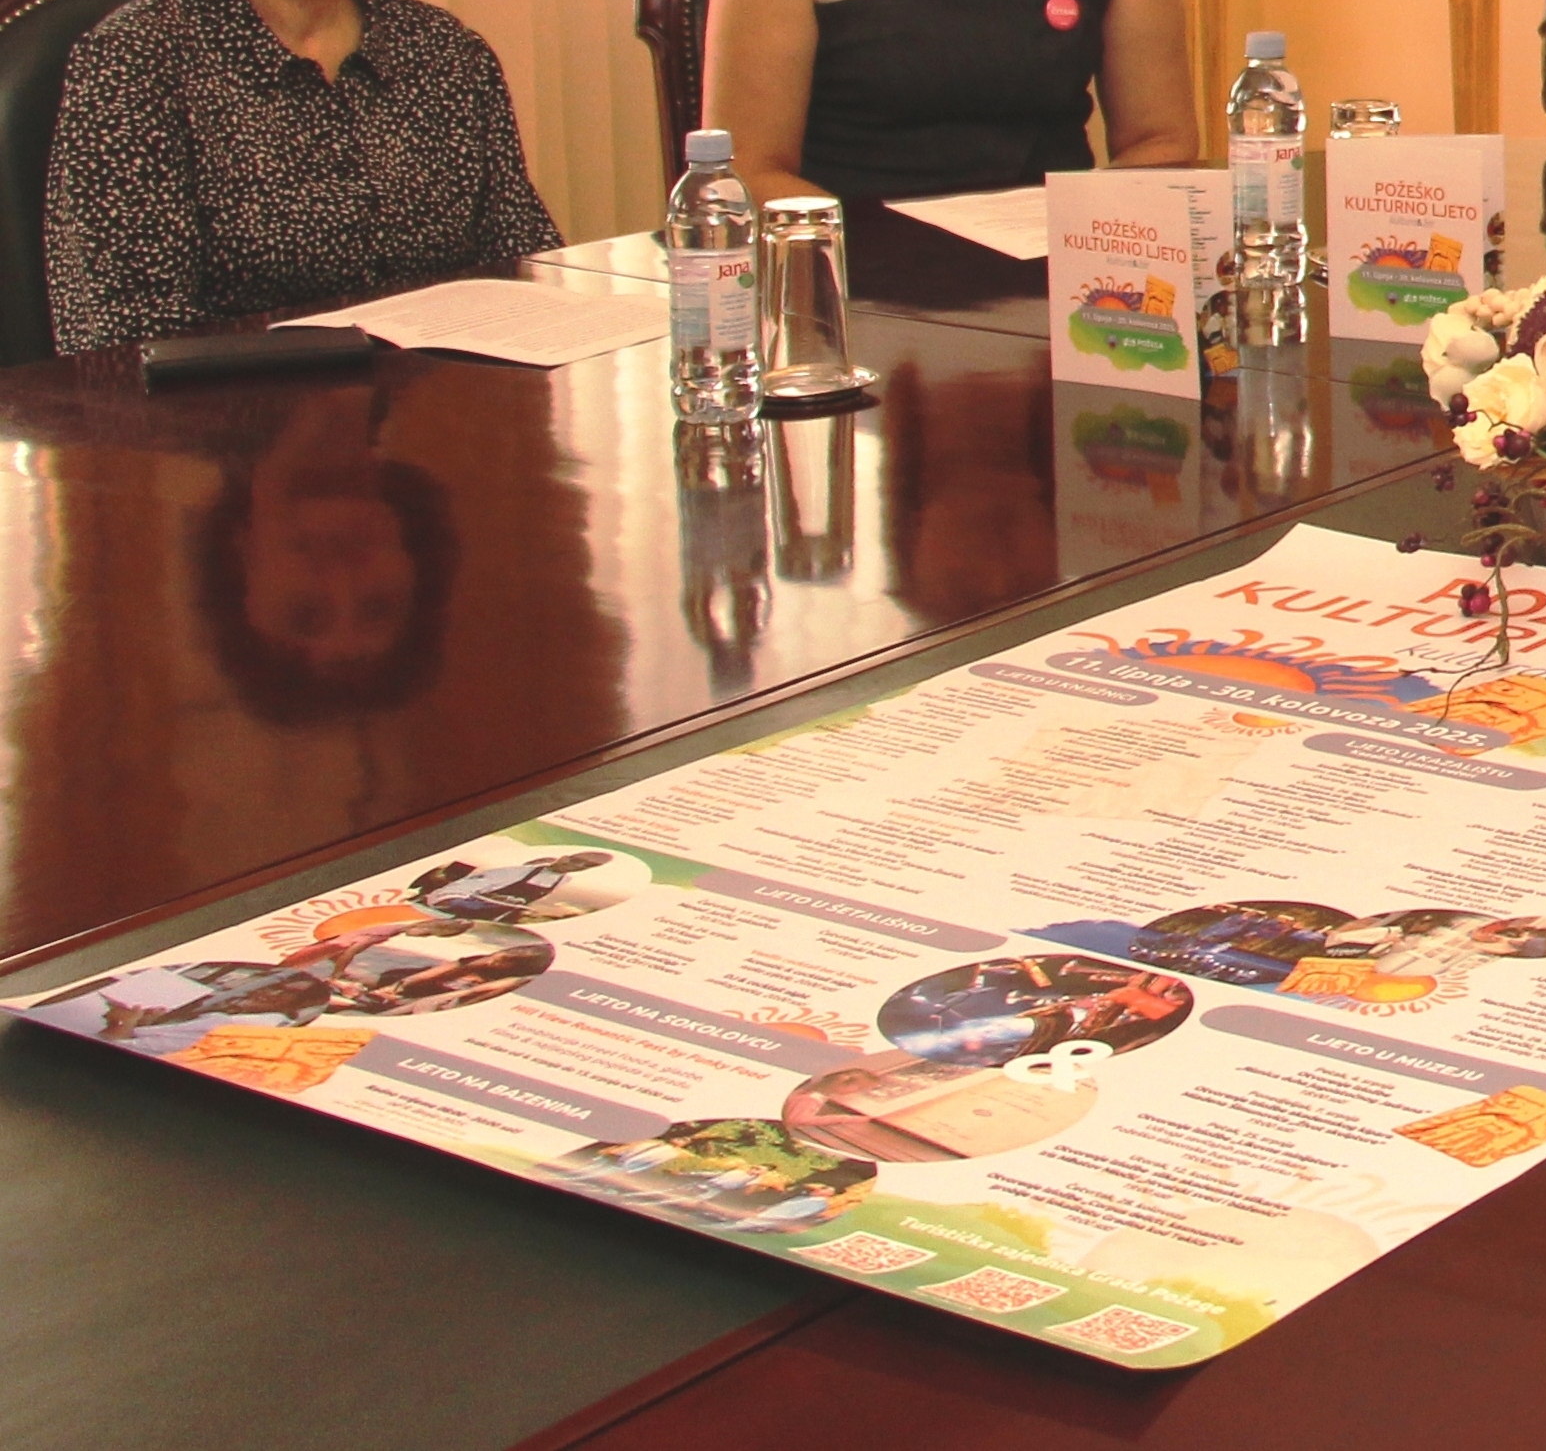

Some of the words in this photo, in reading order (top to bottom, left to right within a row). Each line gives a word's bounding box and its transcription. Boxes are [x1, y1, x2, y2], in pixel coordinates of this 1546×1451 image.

[1344, 196, 1428, 216] KULTURNO
[1432, 203, 1477, 221] LJETO
[1375, 180, 1445, 201] POŽEŠKO
[1064, 234, 1142, 257] KULTURNO
[1146, 244, 1187, 263] LJETO
[1092, 219, 1158, 242] POŽEŠKO
[717, 261, 750, 280] Jana
[1062, 656, 1106, 671] 11.
[1106, 665, 1194, 688] lipnja
[1208, 685, 1259, 701] 30.
[1259, 695, 1403, 728] kolovoza
[1401, 722, 1490, 746] 2025.
[1344, 740, 1401, 755] LJETO
[1415, 754, 1514, 778] KAZALIŠTU
[753, 886, 813, 904] LJETO
[824, 903, 939, 935] ŠETALIŠNOJ
[568, 989, 632, 1010] LJETO
[626, 1005, 661, 1019] NA
[657, 1014, 781, 1050] SOKOLOVCU
[1305, 1034, 1375, 1055] LJETO
[1374, 1050, 1396, 1060] U
[1392, 1055, 1484, 1081] MUZEJU
[396, 1058, 462, 1080] LJETO
[455, 1075, 491, 1090] NA
[486, 1084, 592, 1119] BAZENIMA
[898, 1216, 995, 1250] Turistička
[991, 1245, 1091, 1277] zajednica
[1086, 1269, 1149, 1294] Grada
[1146, 1287, 1227, 1315] Požege
